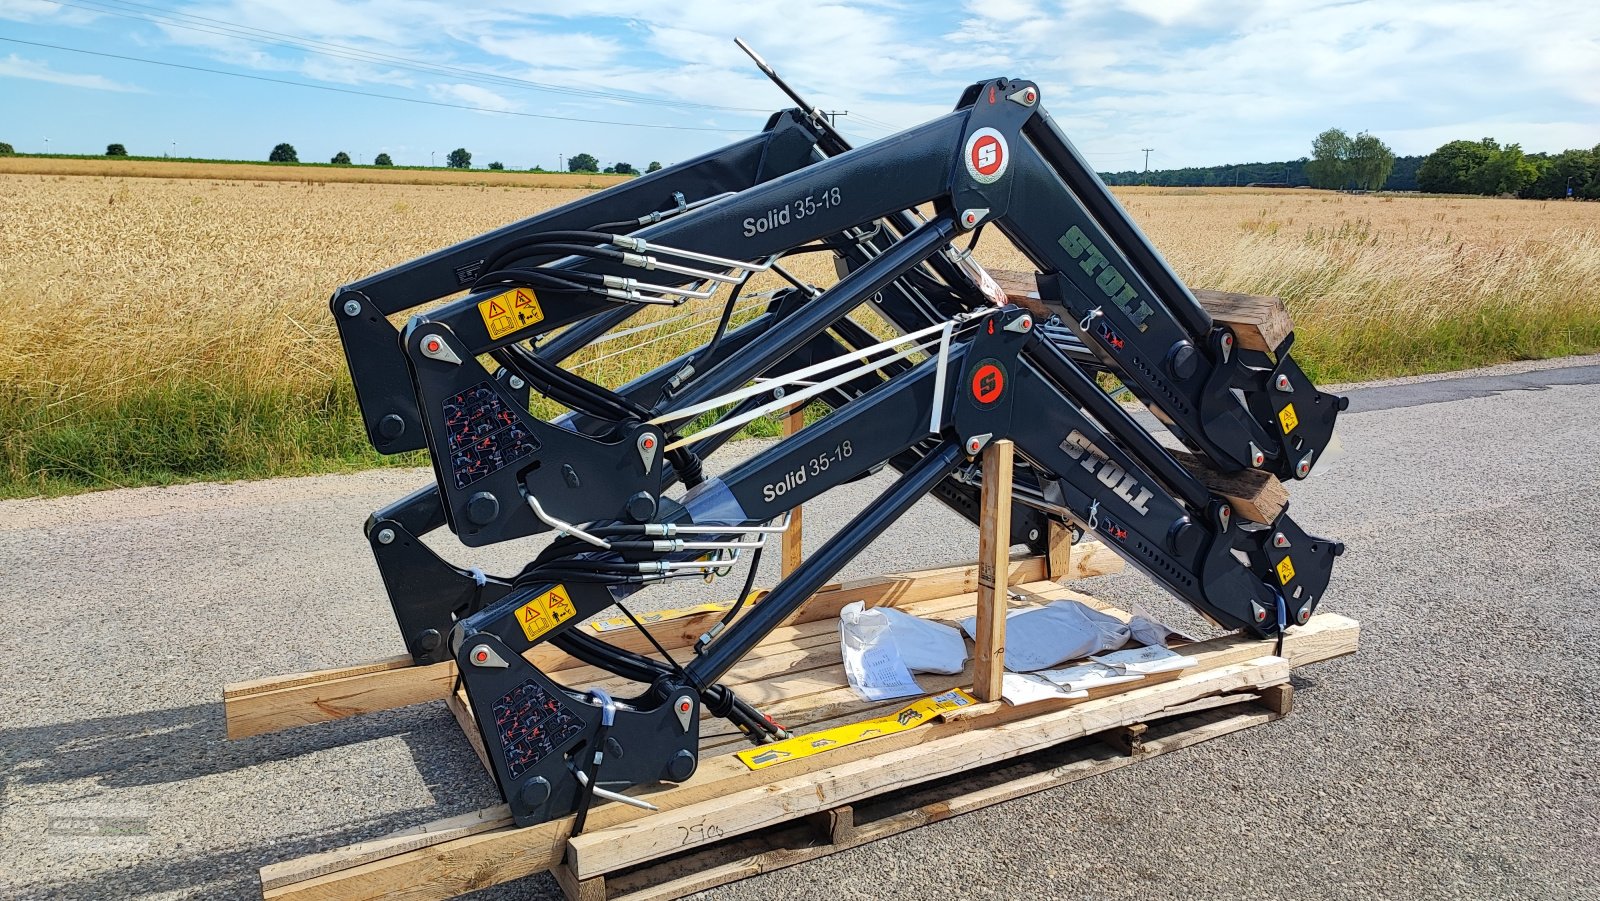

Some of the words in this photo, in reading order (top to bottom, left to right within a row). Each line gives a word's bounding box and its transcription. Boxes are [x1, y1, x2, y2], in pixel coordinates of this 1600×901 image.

[743, 204, 790, 237] Solid
[794, 187, 841, 219] 35-18
[1057, 224, 1155, 334] STOLL
[763, 465, 807, 502] Solid
[809, 440, 852, 476] 35-18
[1058, 428, 1155, 517] STOLL
